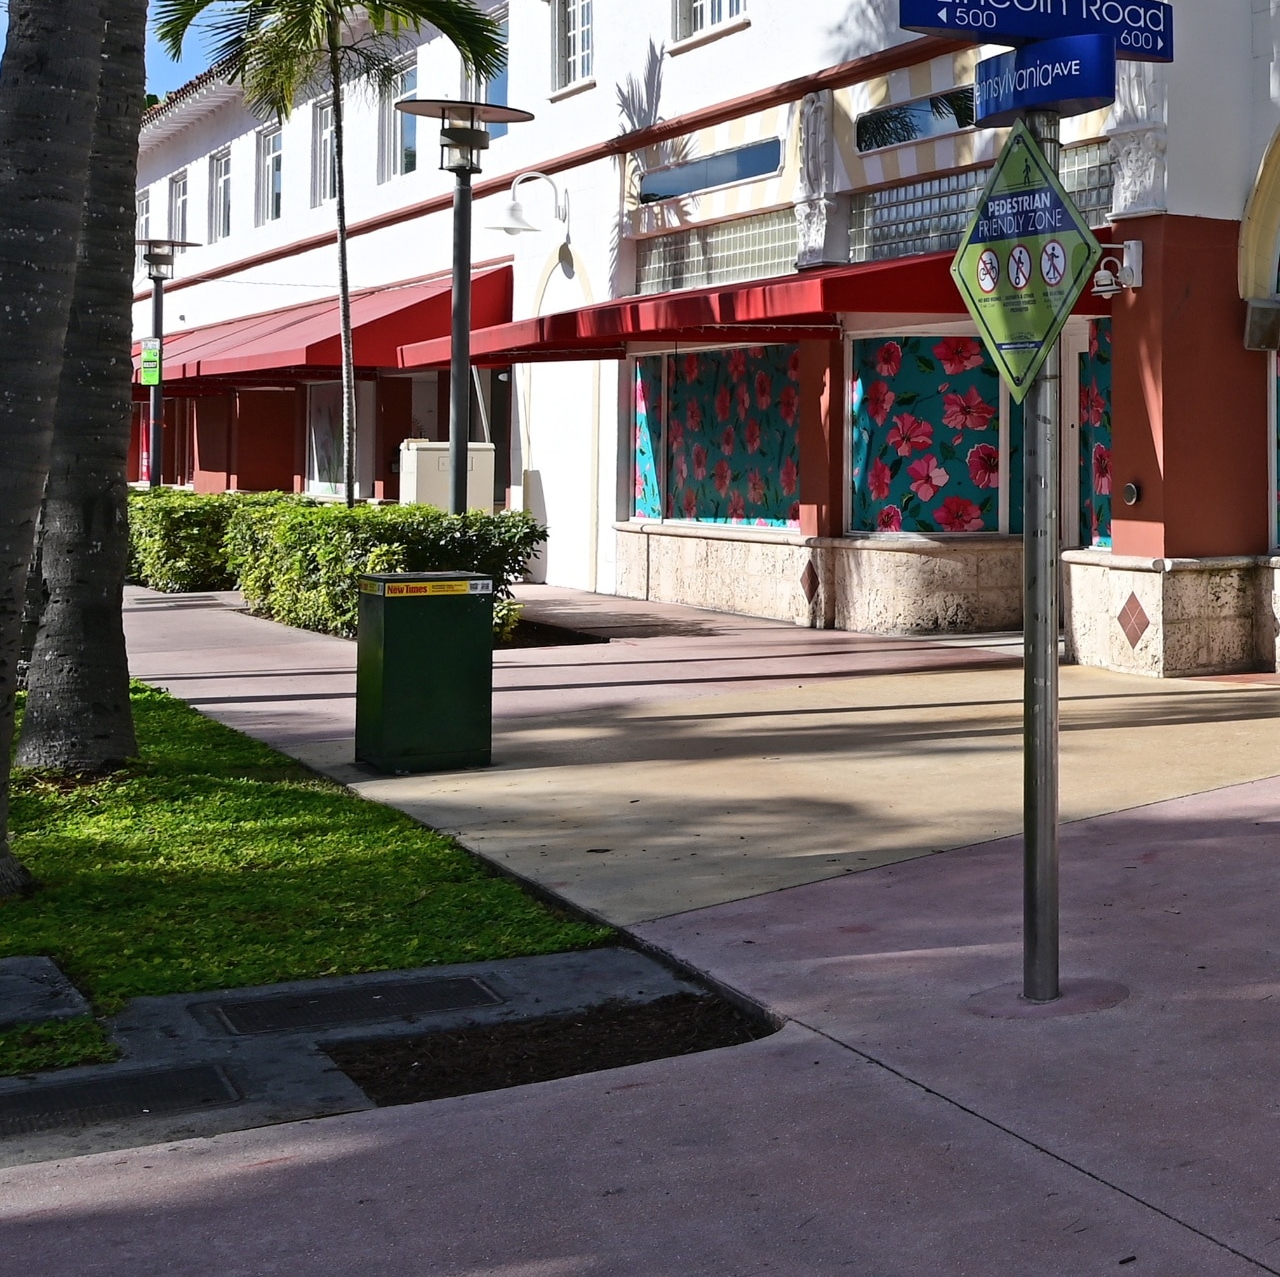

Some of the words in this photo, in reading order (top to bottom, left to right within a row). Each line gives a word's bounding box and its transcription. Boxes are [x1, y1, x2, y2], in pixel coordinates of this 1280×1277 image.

[955, 7, 997, 28] 500
[1120, 29, 1152, 49] 600
[975, 60, 1052, 104] ennsylvania
[988, 192, 1051, 217] PEDESTRIAN
[978, 214, 1025, 238] FRIENDLY
[1028, 208, 1062, 231] ZONE
[387, 584, 404, 594] New
[404, 584, 428, 594] Times
